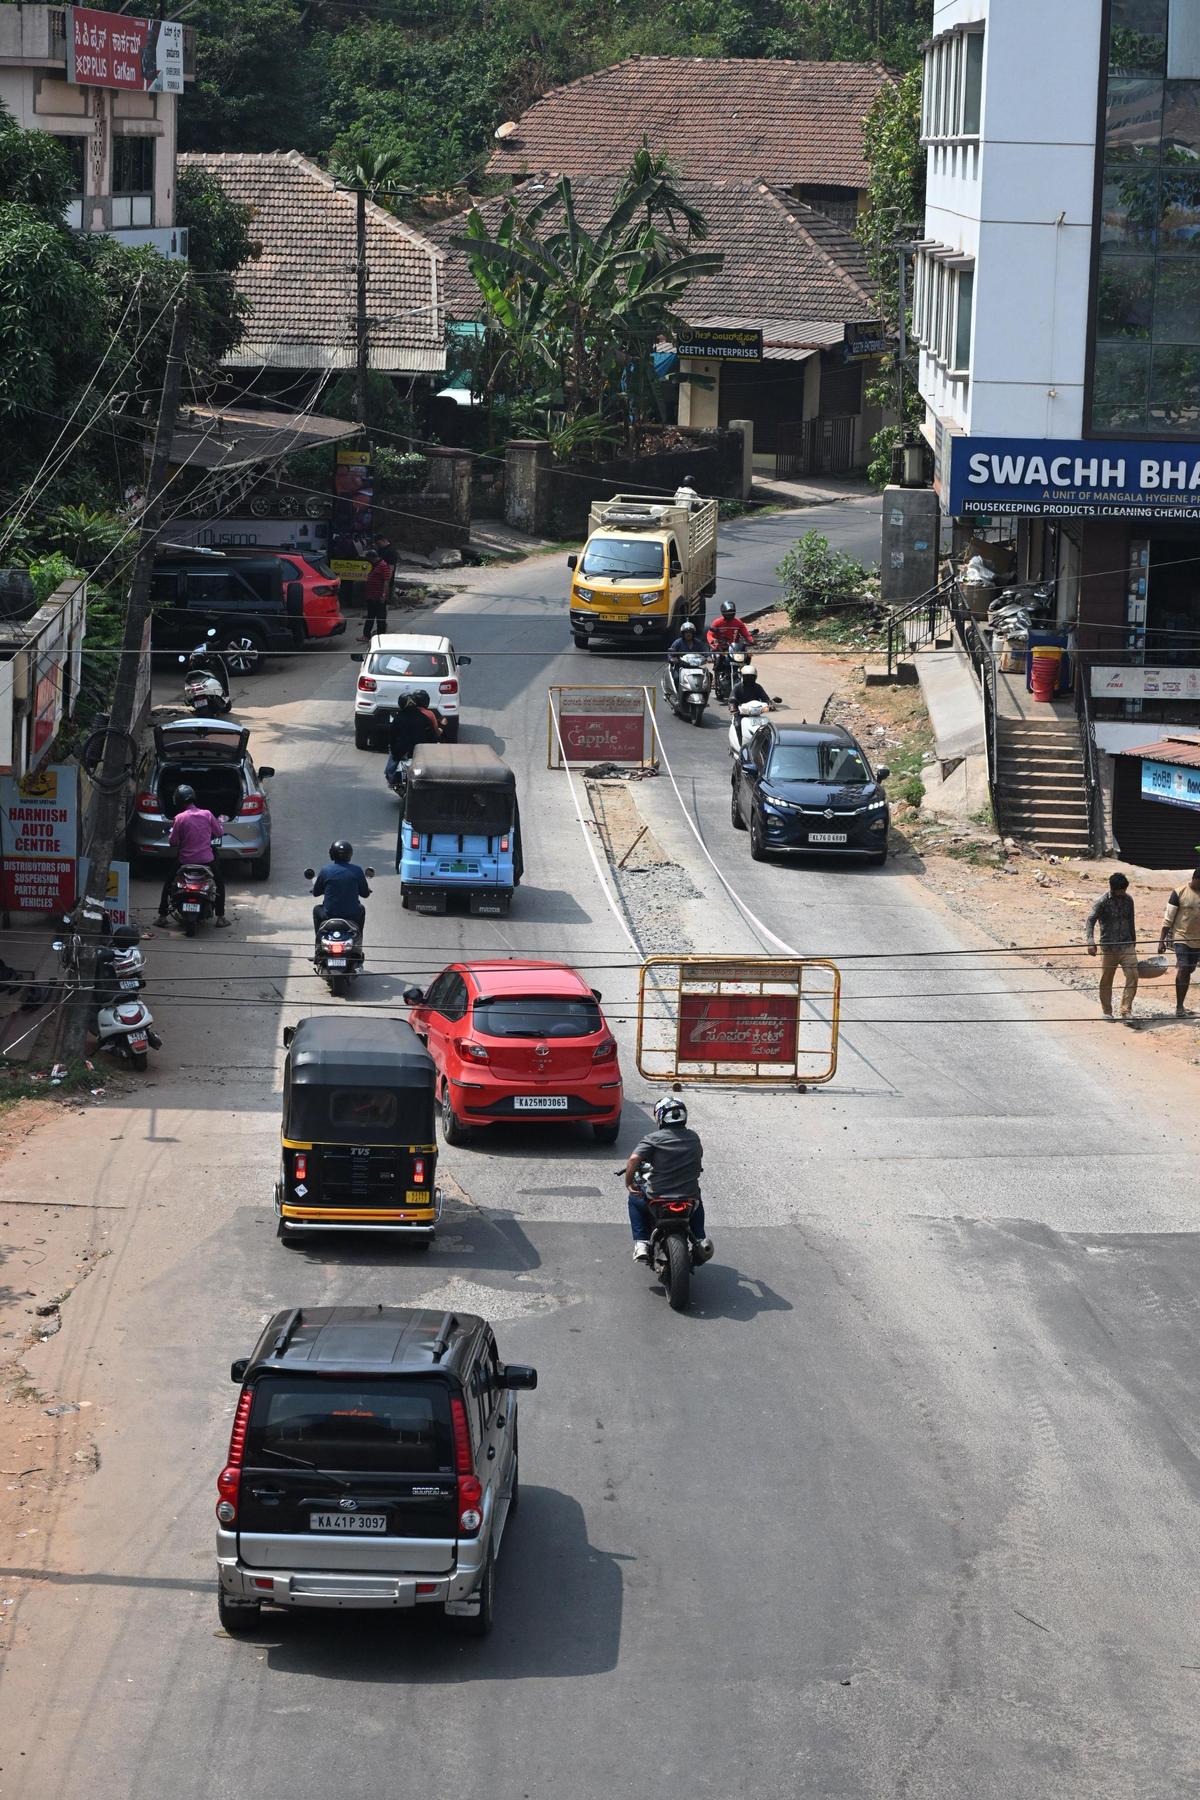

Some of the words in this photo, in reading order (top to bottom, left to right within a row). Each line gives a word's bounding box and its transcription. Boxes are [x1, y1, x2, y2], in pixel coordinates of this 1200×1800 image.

[92, 57, 107, 78] PLUS
[113, 60, 136, 81] CarKam
[679, 345, 705, 355] GEETH
[707, 347, 759, 358] ENTERPRISES
[968, 453, 1126, 487] SWACHH
[1043, 490, 1050, 499] A
[1052, 490, 1077, 500] UNIT
[1078, 491, 1092, 500] OF
[1094, 492, 1143, 502] MANGALA
[1146, 494, 1188, 503] HYGIENE
[965, 502, 1041, 513] HOUSEKEEPING
[1043, 504, 1095, 515] PRODUCTS
[1102, 506, 1152, 517] CLEANING
[1154, 508, 1200, 518] CHEMICA
[577, 730, 618, 748] apple
[9, 808, 67, 822] HARNIISH
[21, 823, 54, 837] AUTO
[15, 838, 61, 852] CENTRE
[4, 861, 56, 872] DISTRIBUTORS
[57, 863, 71, 873] FOR
[14, 874, 59, 884] SUSPENSION
[14, 885, 37, 895] PARTS
[38, 886, 47, 895] OF
[48, 887, 59, 896] ALL
[20, 898, 53, 908] VEHICLES
[350, 1147, 371, 1156] TVS
[359, 1517, 386, 1529] 3097
